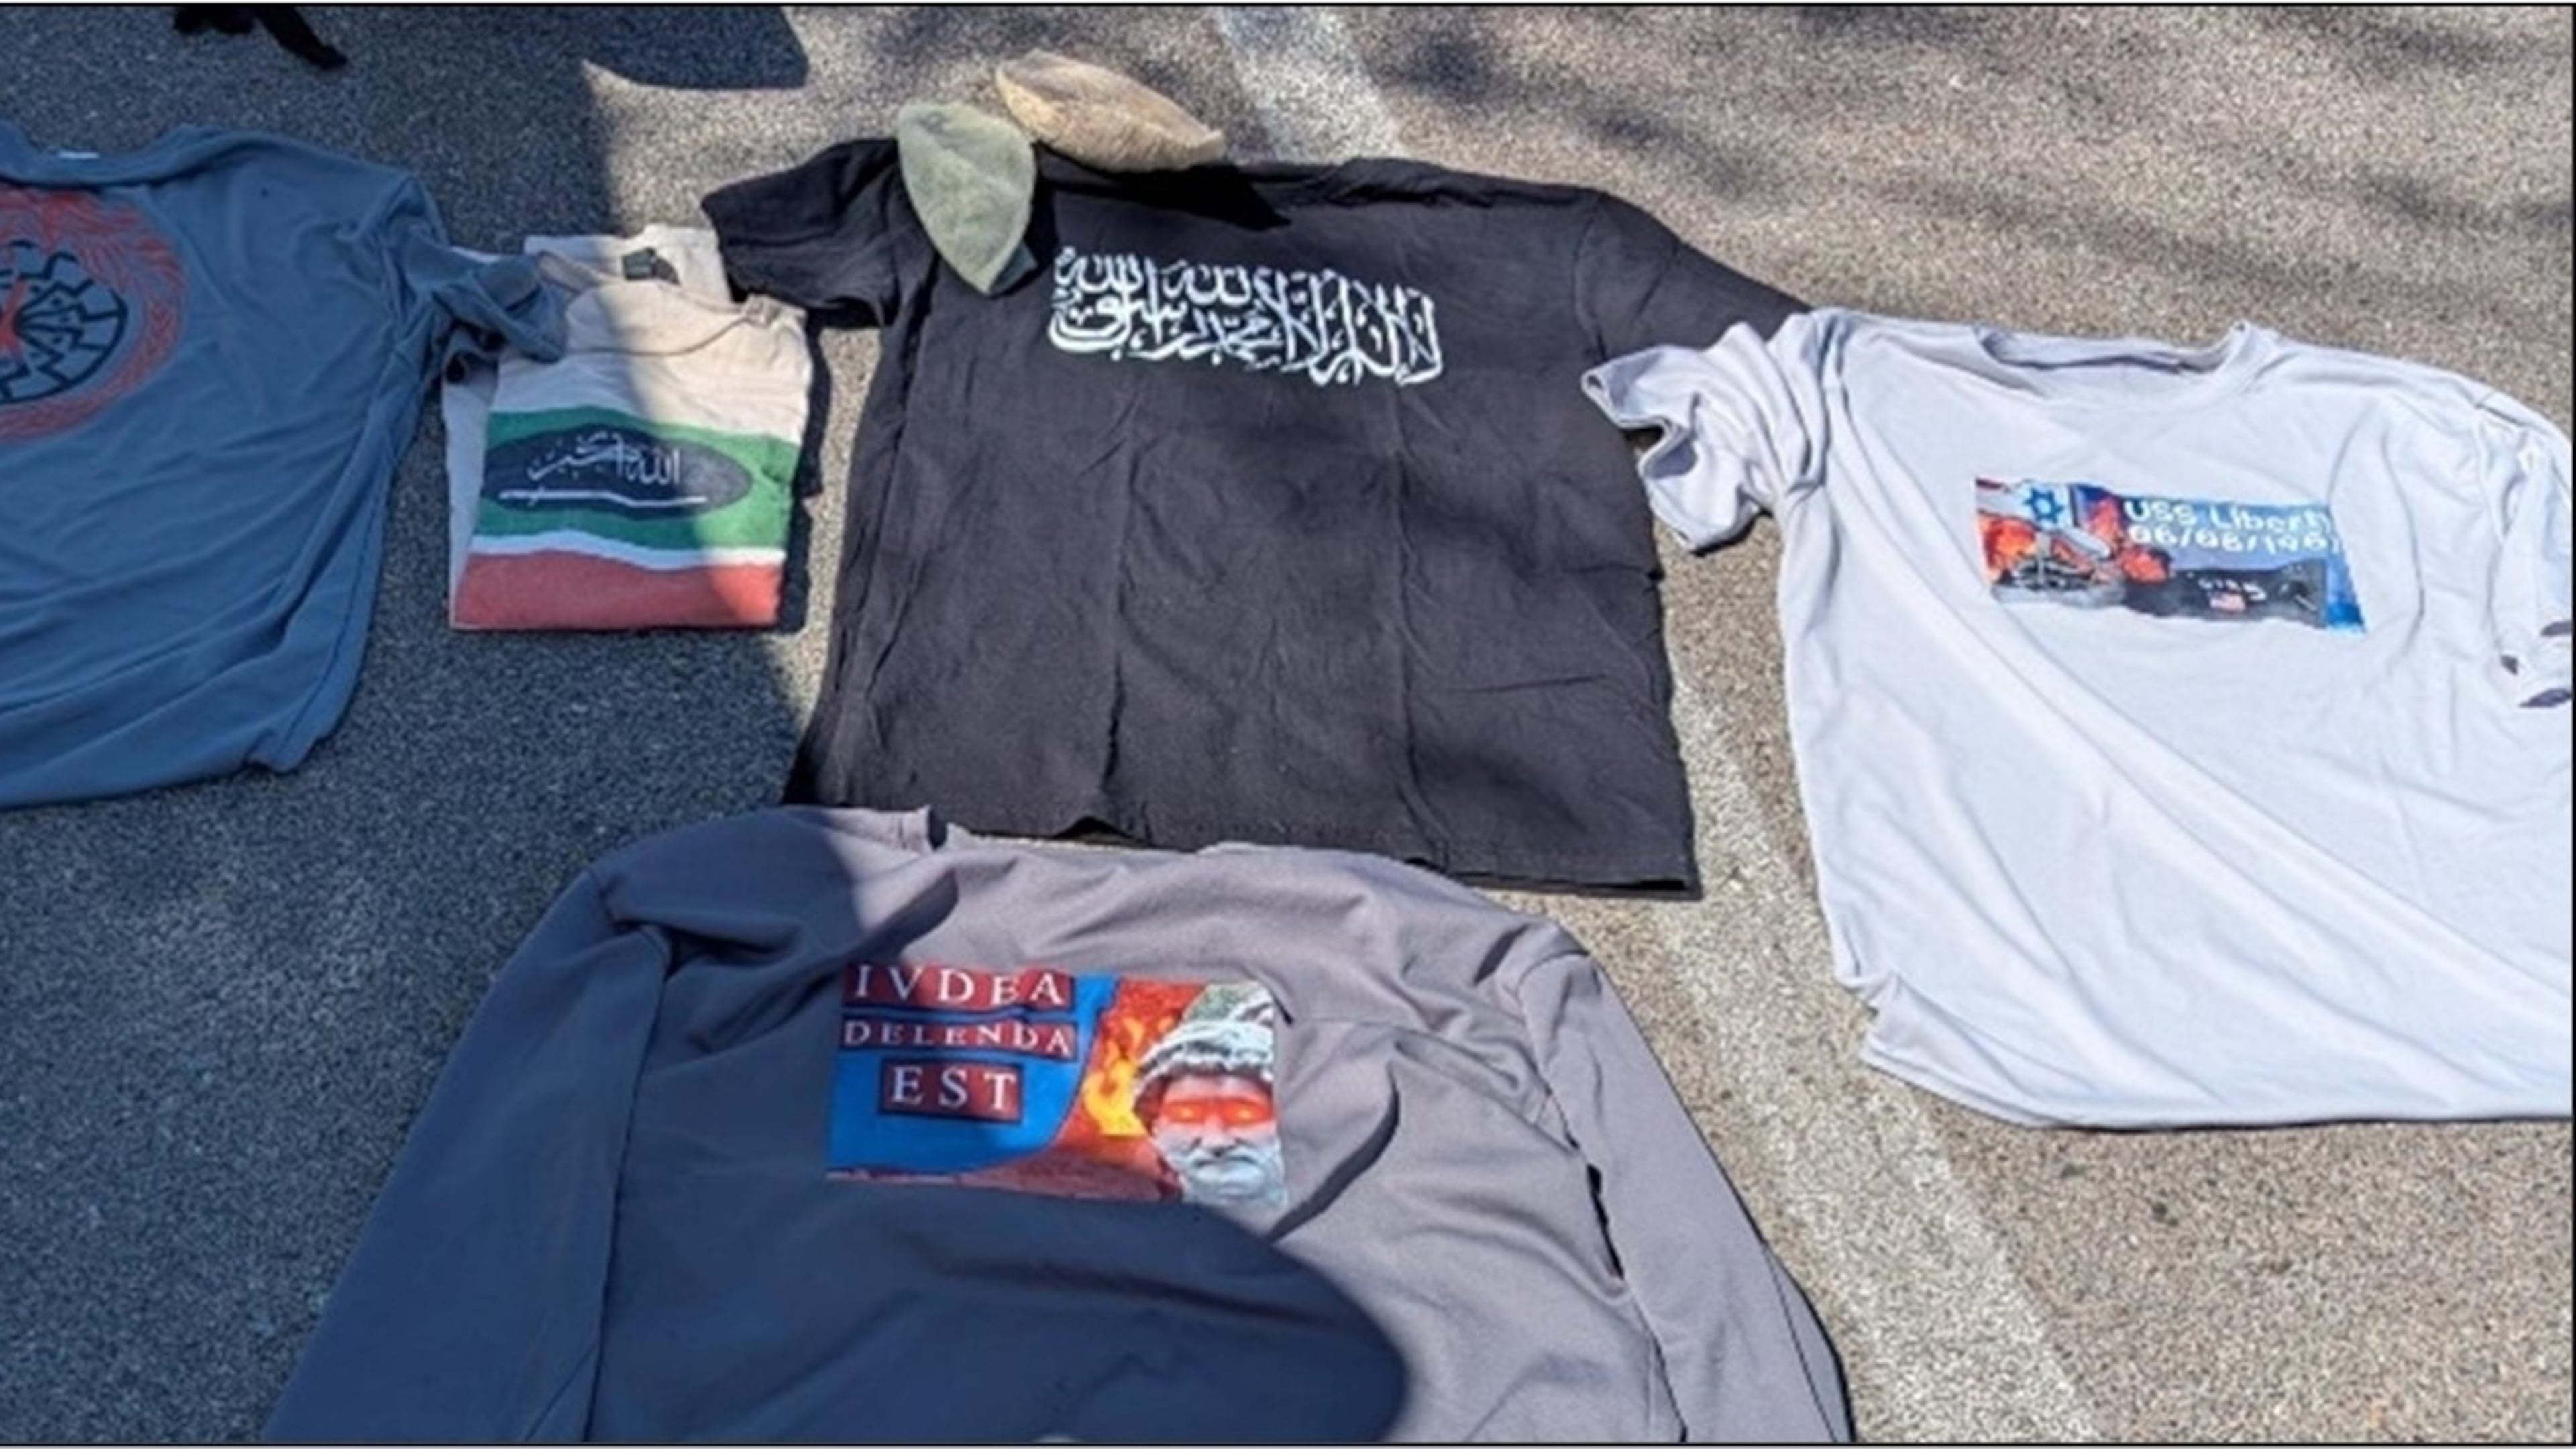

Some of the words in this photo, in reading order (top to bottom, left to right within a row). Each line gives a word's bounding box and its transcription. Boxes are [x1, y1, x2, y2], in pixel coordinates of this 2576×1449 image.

[2124, 500, 2197, 526] USS
[855, 965, 1064, 1006] IVDEA
[843, 1020, 1071, 1059] DELENDA
[892, 1065, 1017, 1111] EST
